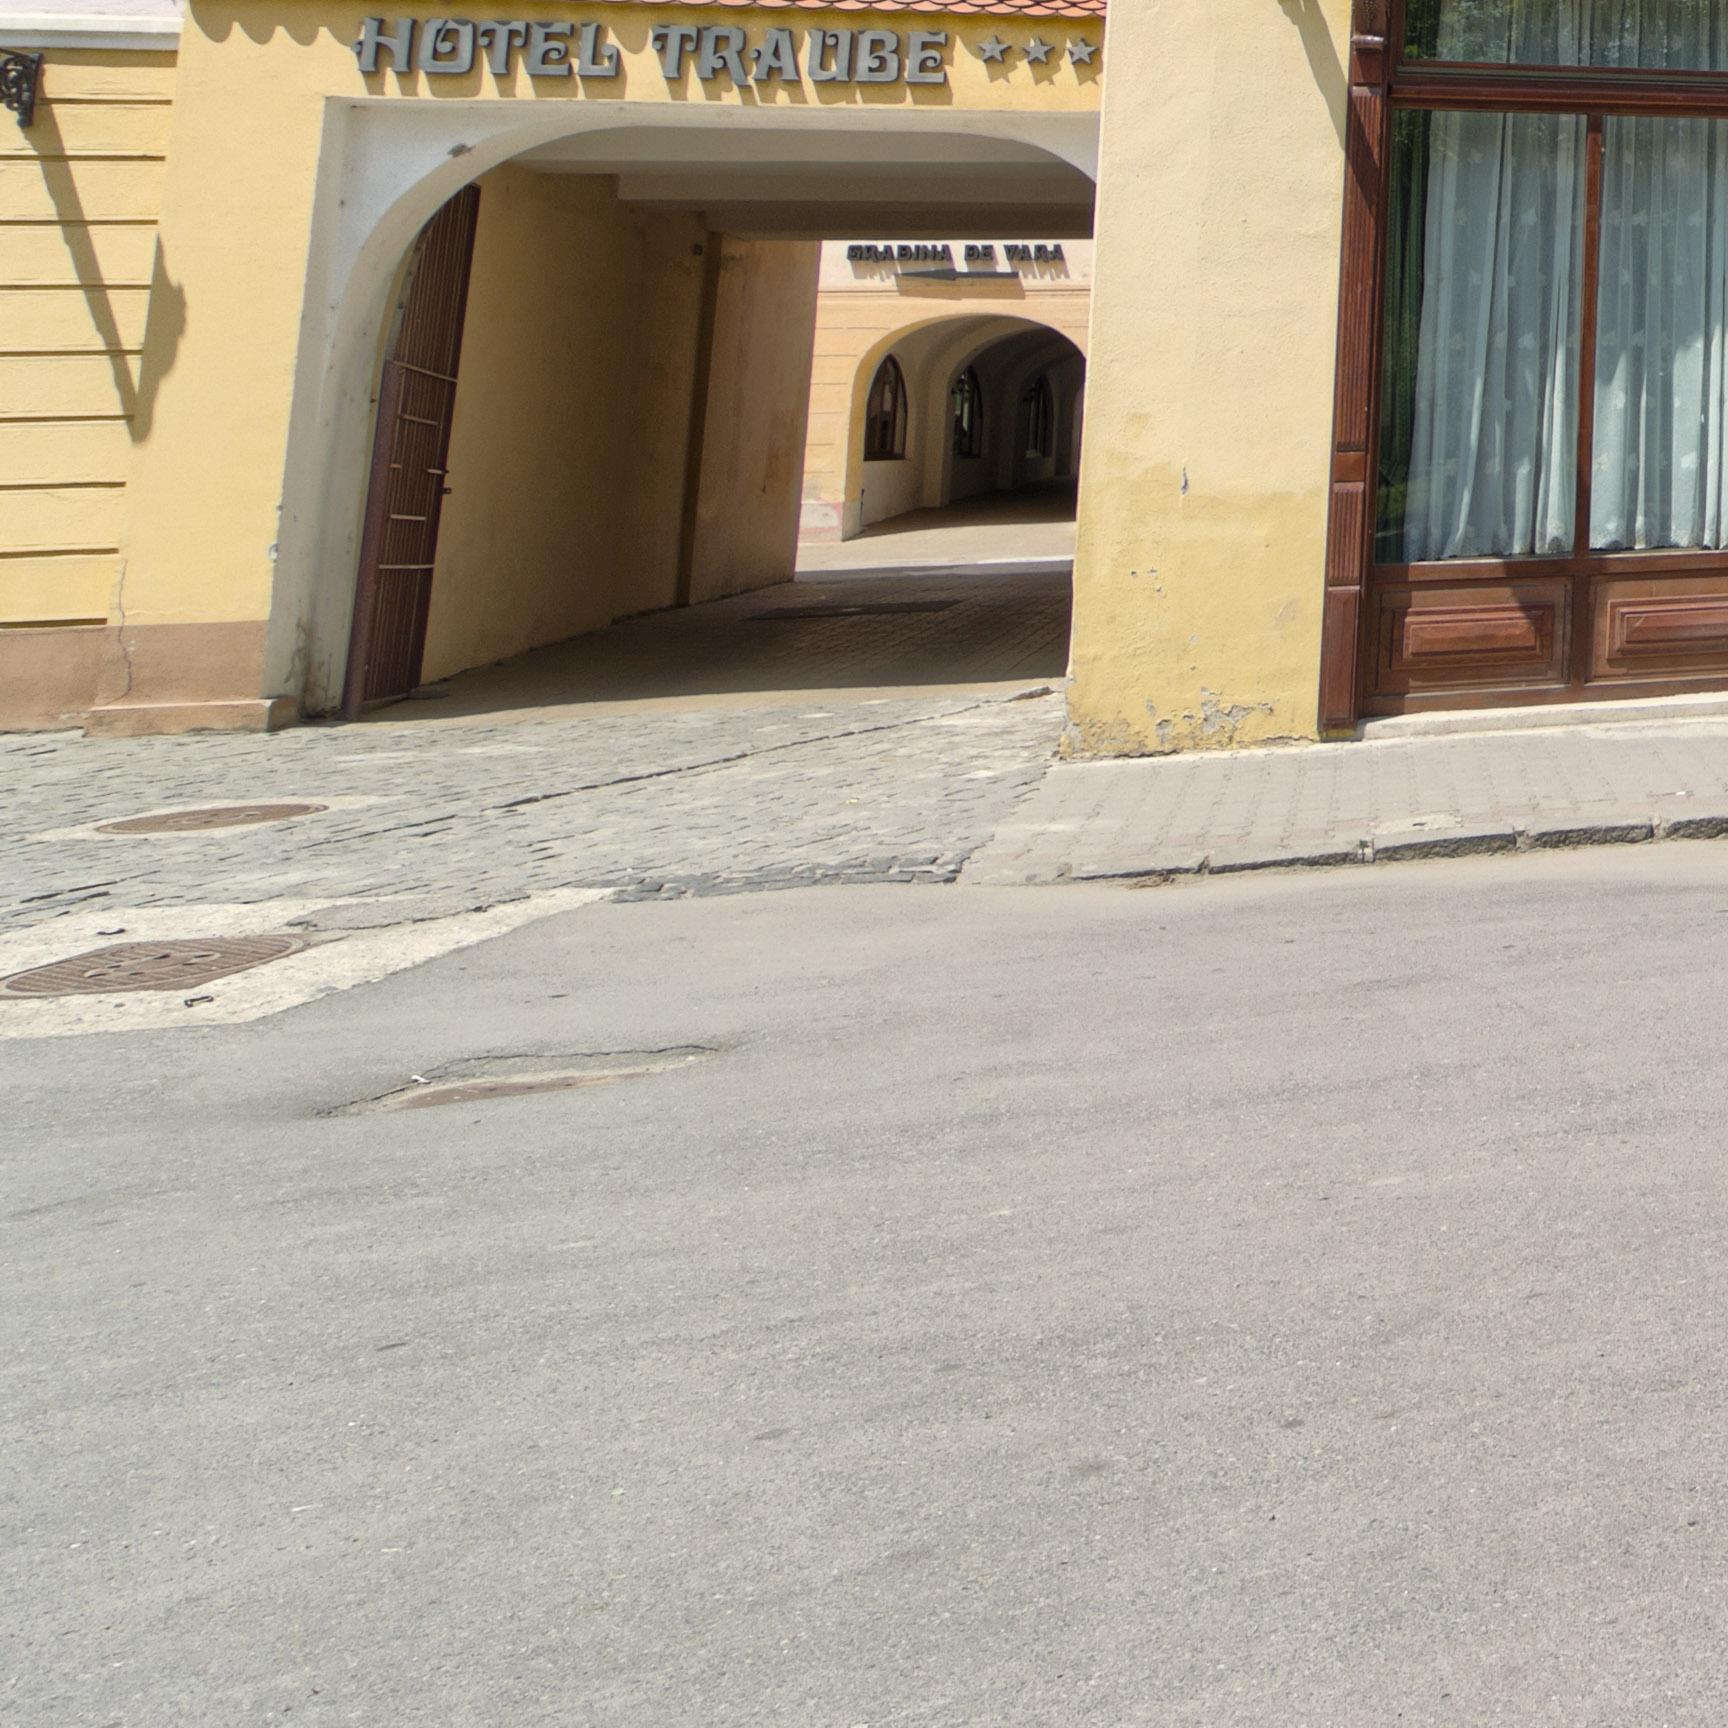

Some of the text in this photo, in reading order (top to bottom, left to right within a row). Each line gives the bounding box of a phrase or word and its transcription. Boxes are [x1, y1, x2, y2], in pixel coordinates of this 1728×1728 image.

[352, 16, 949, 86] HOTEL TRAUBE
[846, 244, 1066, 263] GRADINA DE VARA
